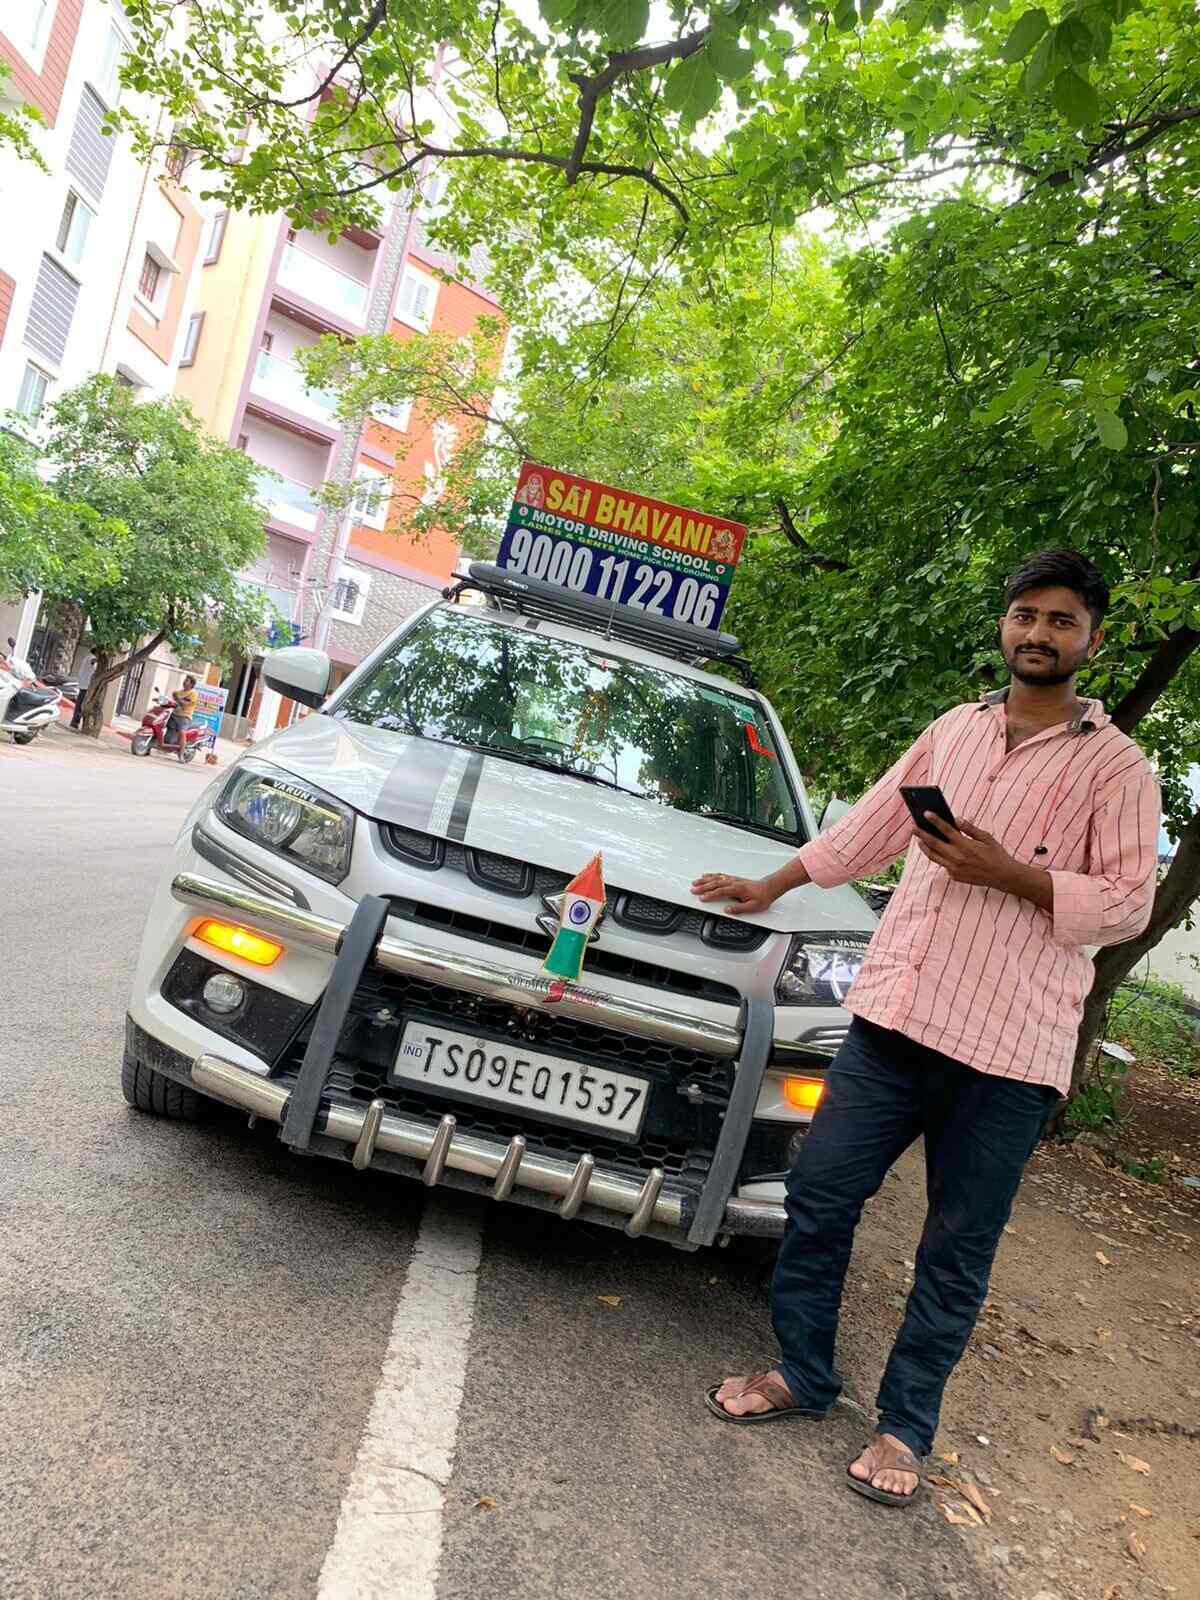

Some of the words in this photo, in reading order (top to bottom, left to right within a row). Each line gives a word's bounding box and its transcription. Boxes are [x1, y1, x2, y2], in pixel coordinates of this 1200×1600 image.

[521, 520, 560, 535] LADIES
[578, 538, 616, 552] GENTS
[618, 548, 641, 560] HOME
[532, 509, 585, 535] MOTOR
[589, 527, 648, 553] DRIVING
[652, 546, 710, 572] SCHOOL
[546, 479, 591, 518] SAI
[595, 496, 713, 553] BHAVANI
[506, 529, 593, 591] 9000
[597, 555, 630, 602] 11
[627, 564, 673, 615] 22
[672, 577, 719, 628] 06
[273, 780, 310, 800] VARUN
[403, 1044, 422, 1058] IND
[423, 1036, 642, 1120] TS09EQ1537
